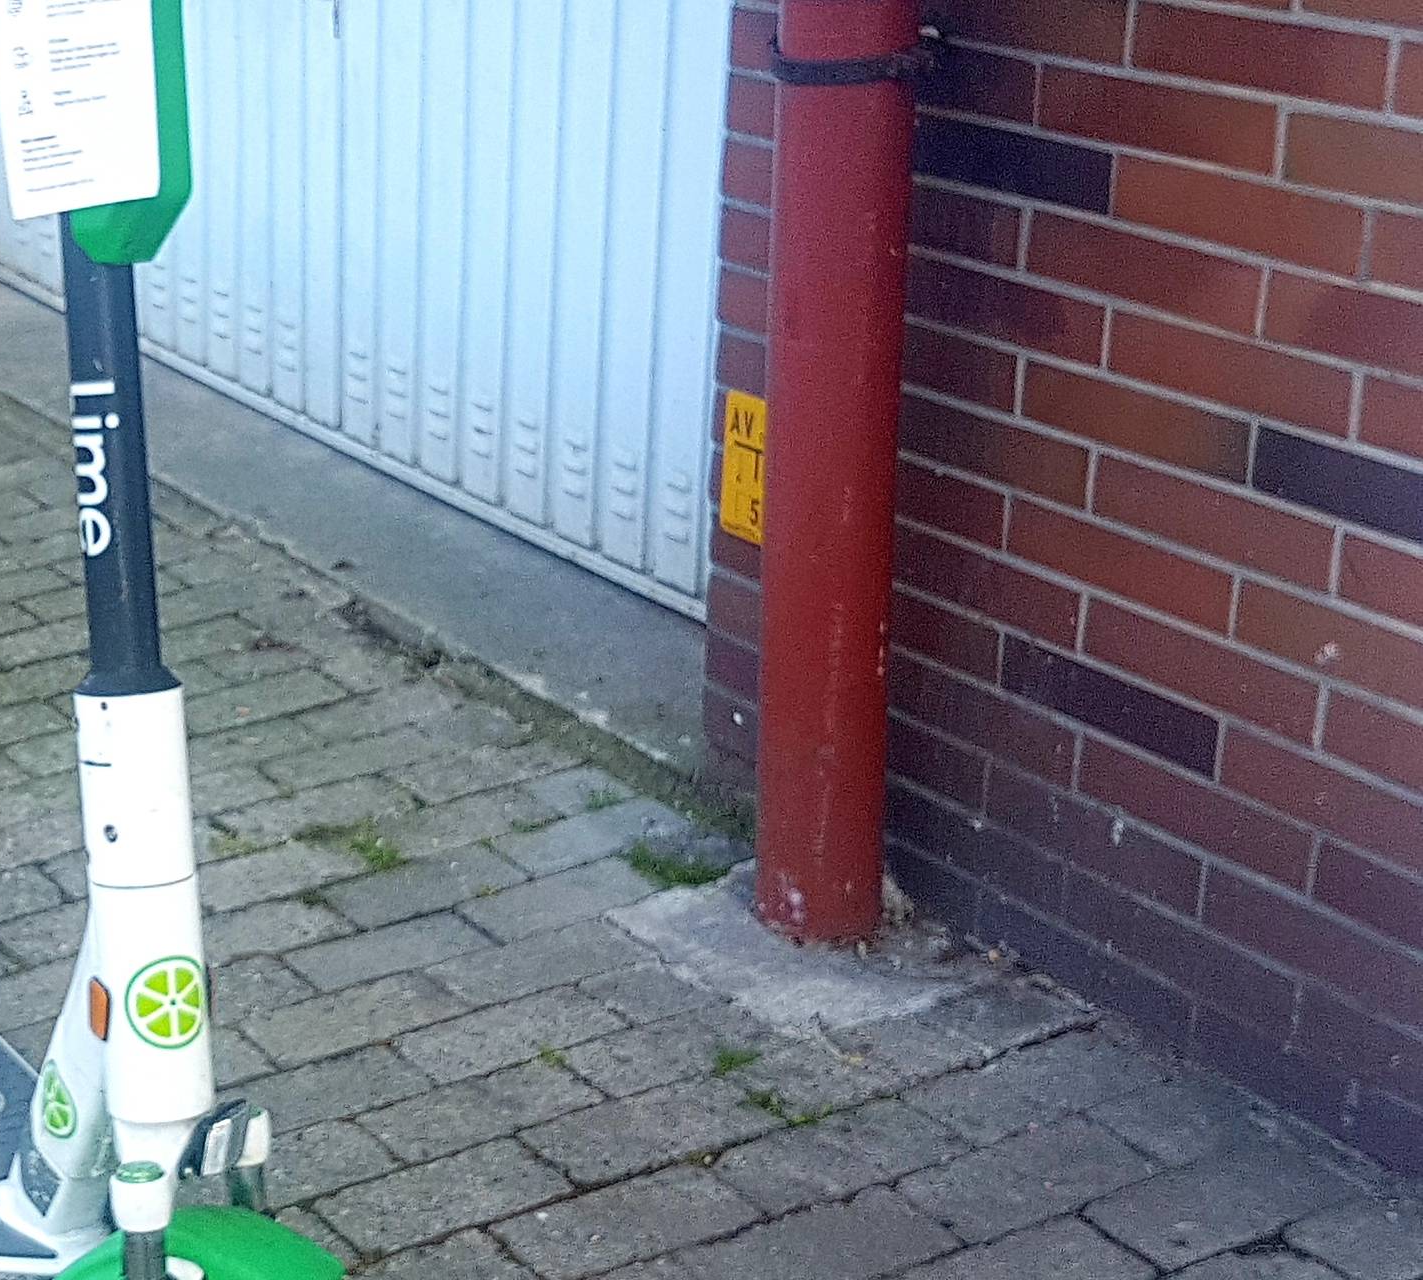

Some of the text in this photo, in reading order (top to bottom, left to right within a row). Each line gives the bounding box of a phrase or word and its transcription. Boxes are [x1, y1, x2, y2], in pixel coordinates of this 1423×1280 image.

[729, 407, 754, 440] AV
[70, 381, 120, 556] Lime
[749, 499, 760, 526] 5
